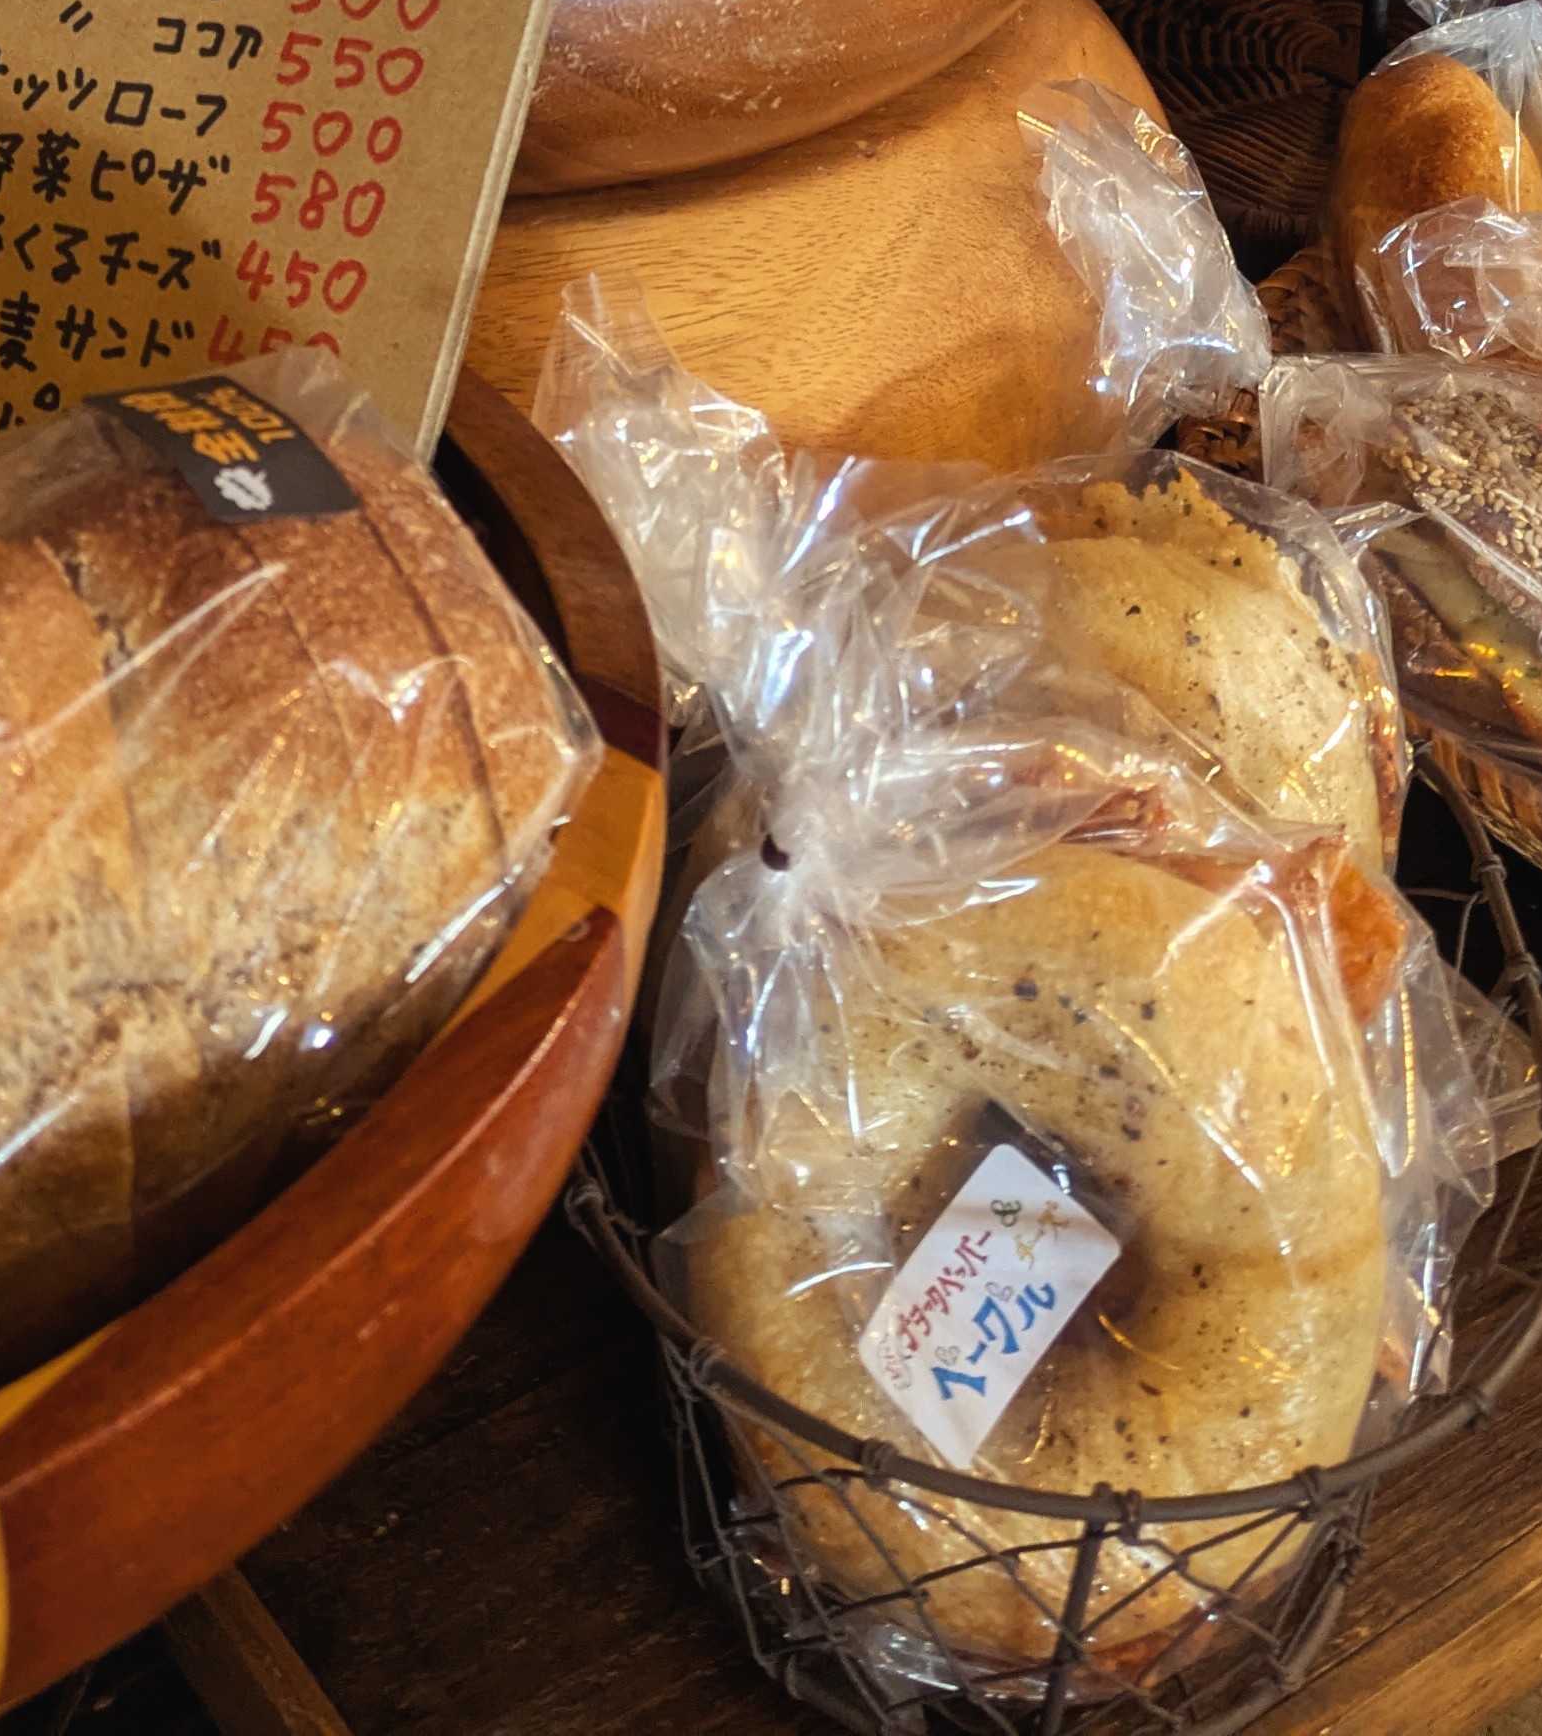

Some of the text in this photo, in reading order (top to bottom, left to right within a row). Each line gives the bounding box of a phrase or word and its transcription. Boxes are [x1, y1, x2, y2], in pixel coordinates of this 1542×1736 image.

[154, 15, 264, 71] ココア
[276, 31, 426, 96] 550
[261, 100, 404, 165] 500
[250, 169, 387, 238] 580
[235, 240, 368, 314] 450
